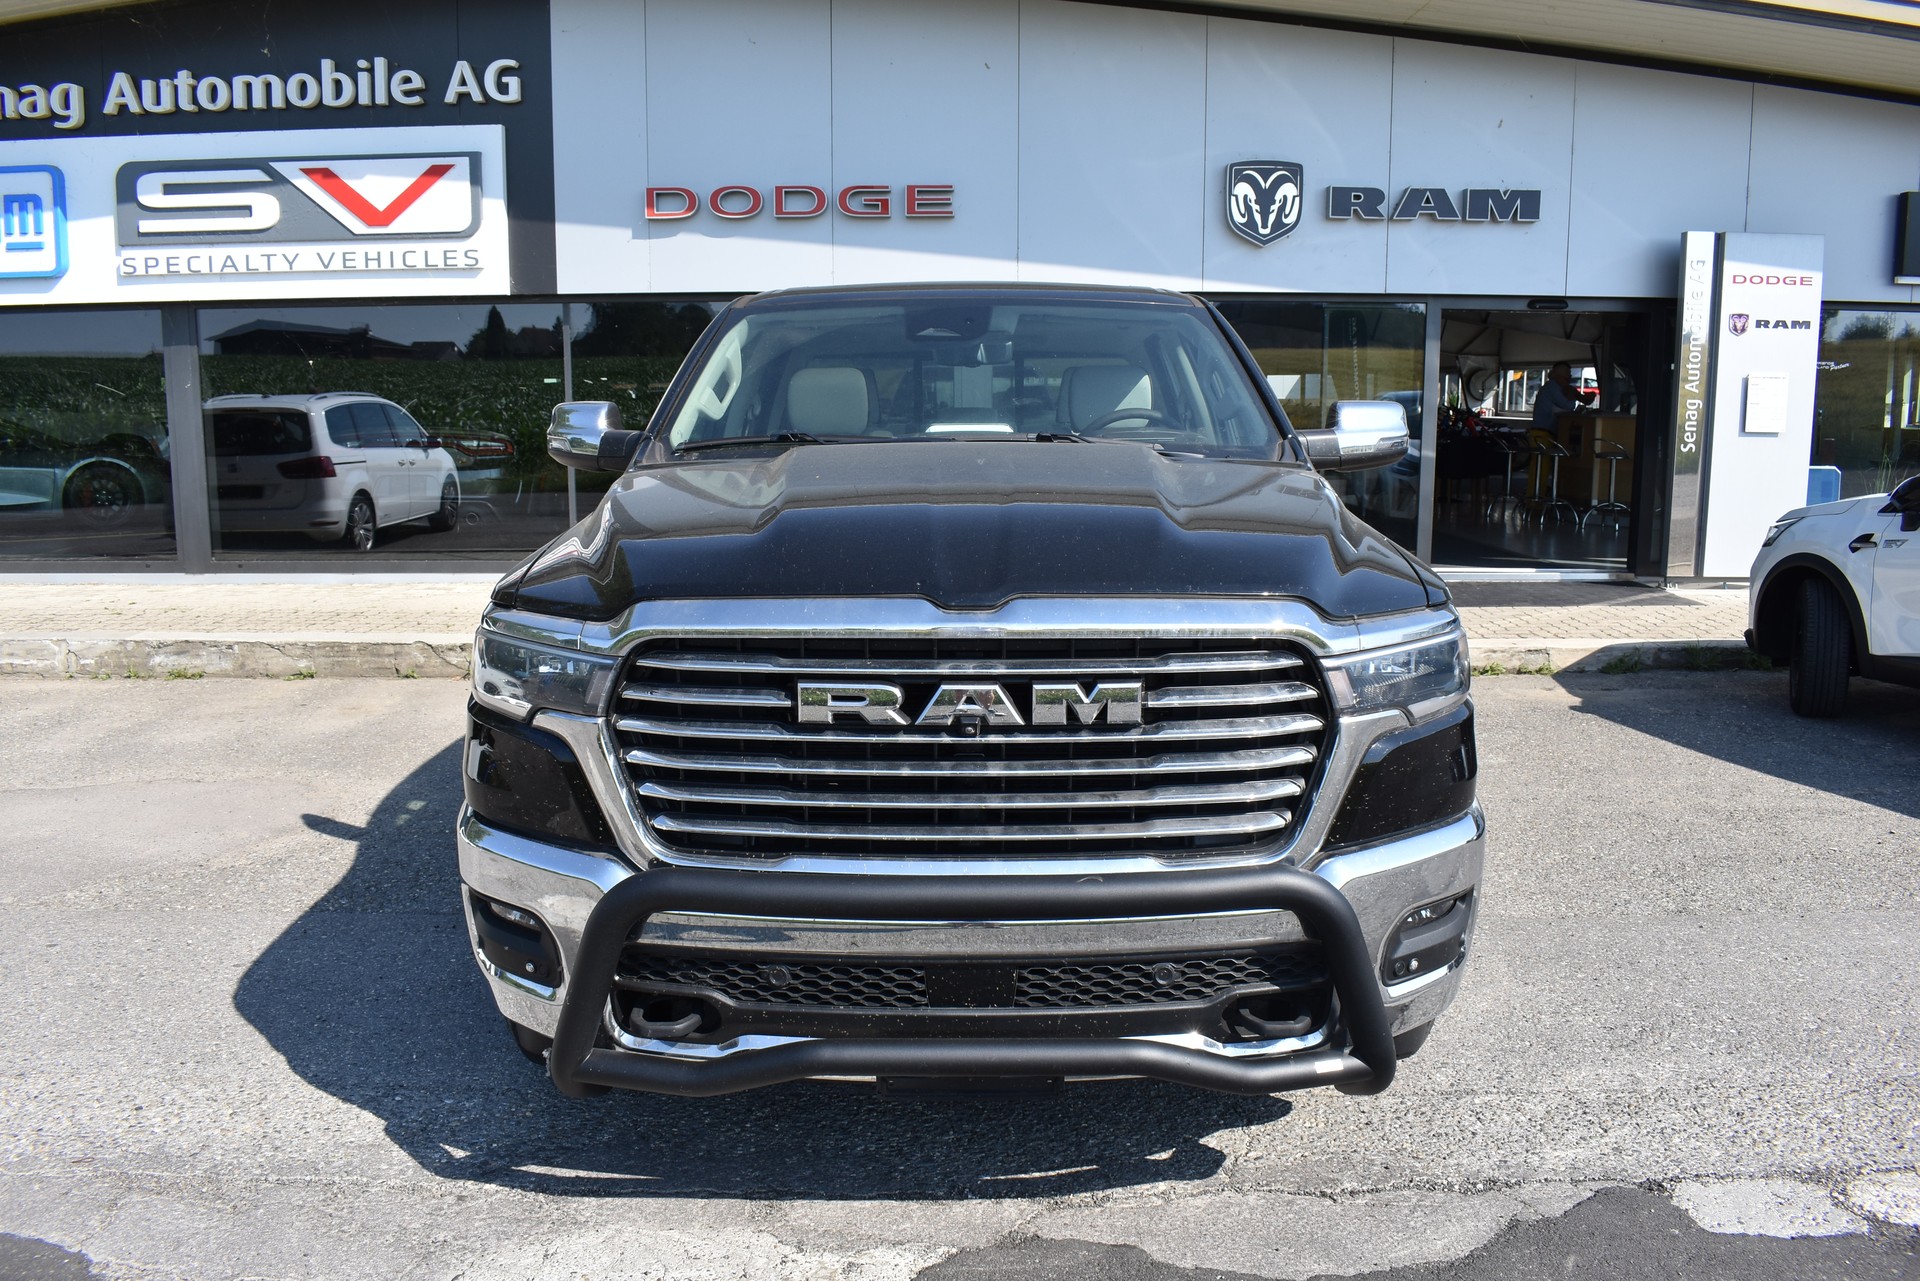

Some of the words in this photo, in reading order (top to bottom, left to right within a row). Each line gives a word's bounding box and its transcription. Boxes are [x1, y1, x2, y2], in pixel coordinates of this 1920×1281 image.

[0, 83, 85, 129] nag
[103, 57, 426, 115] Automobile
[444, 59, 522, 104] AG
[645, 184, 955, 220] DODGE
[1328, 185, 1542, 223] RAM
[122, 251, 300, 275] SPECIALTY
[316, 248, 480, 270] VEHICLES
[1689, 259, 1706, 285] AG
[1732, 274, 1813, 286] DODGE
[1684, 291, 1704, 393] Automobile
[1755, 319, 1811, 330] RAM
[1680, 399, 1703, 453] Senag
[797, 682, 1144, 726] RAM
